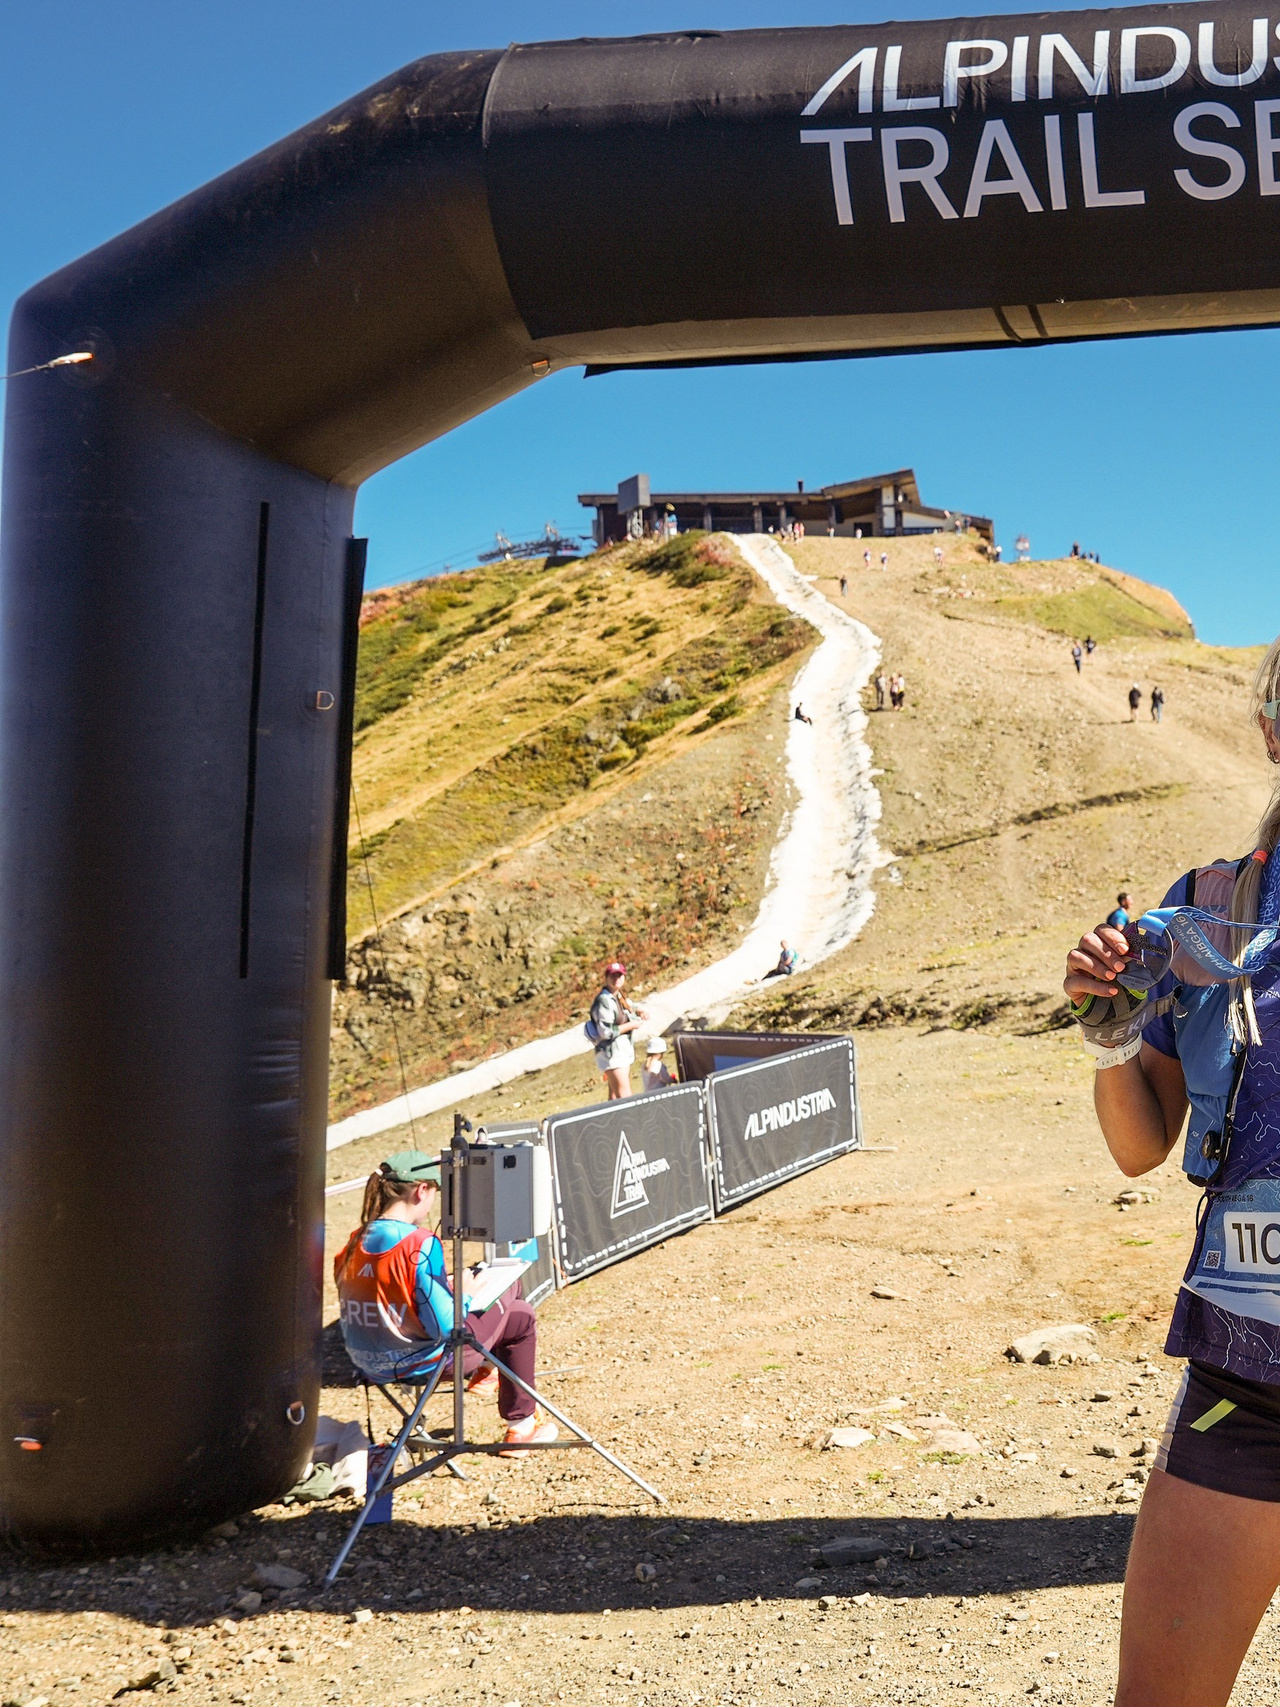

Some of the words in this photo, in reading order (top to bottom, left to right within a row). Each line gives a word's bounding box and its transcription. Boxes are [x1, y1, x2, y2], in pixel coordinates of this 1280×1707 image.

[800, 113, 1146, 226] TRAIL
[1094, 1011, 1147, 1042] LEKI
[744, 1088, 837, 1141] ALPINDUSTRIA
[341, 1298, 408, 1329] CREW
